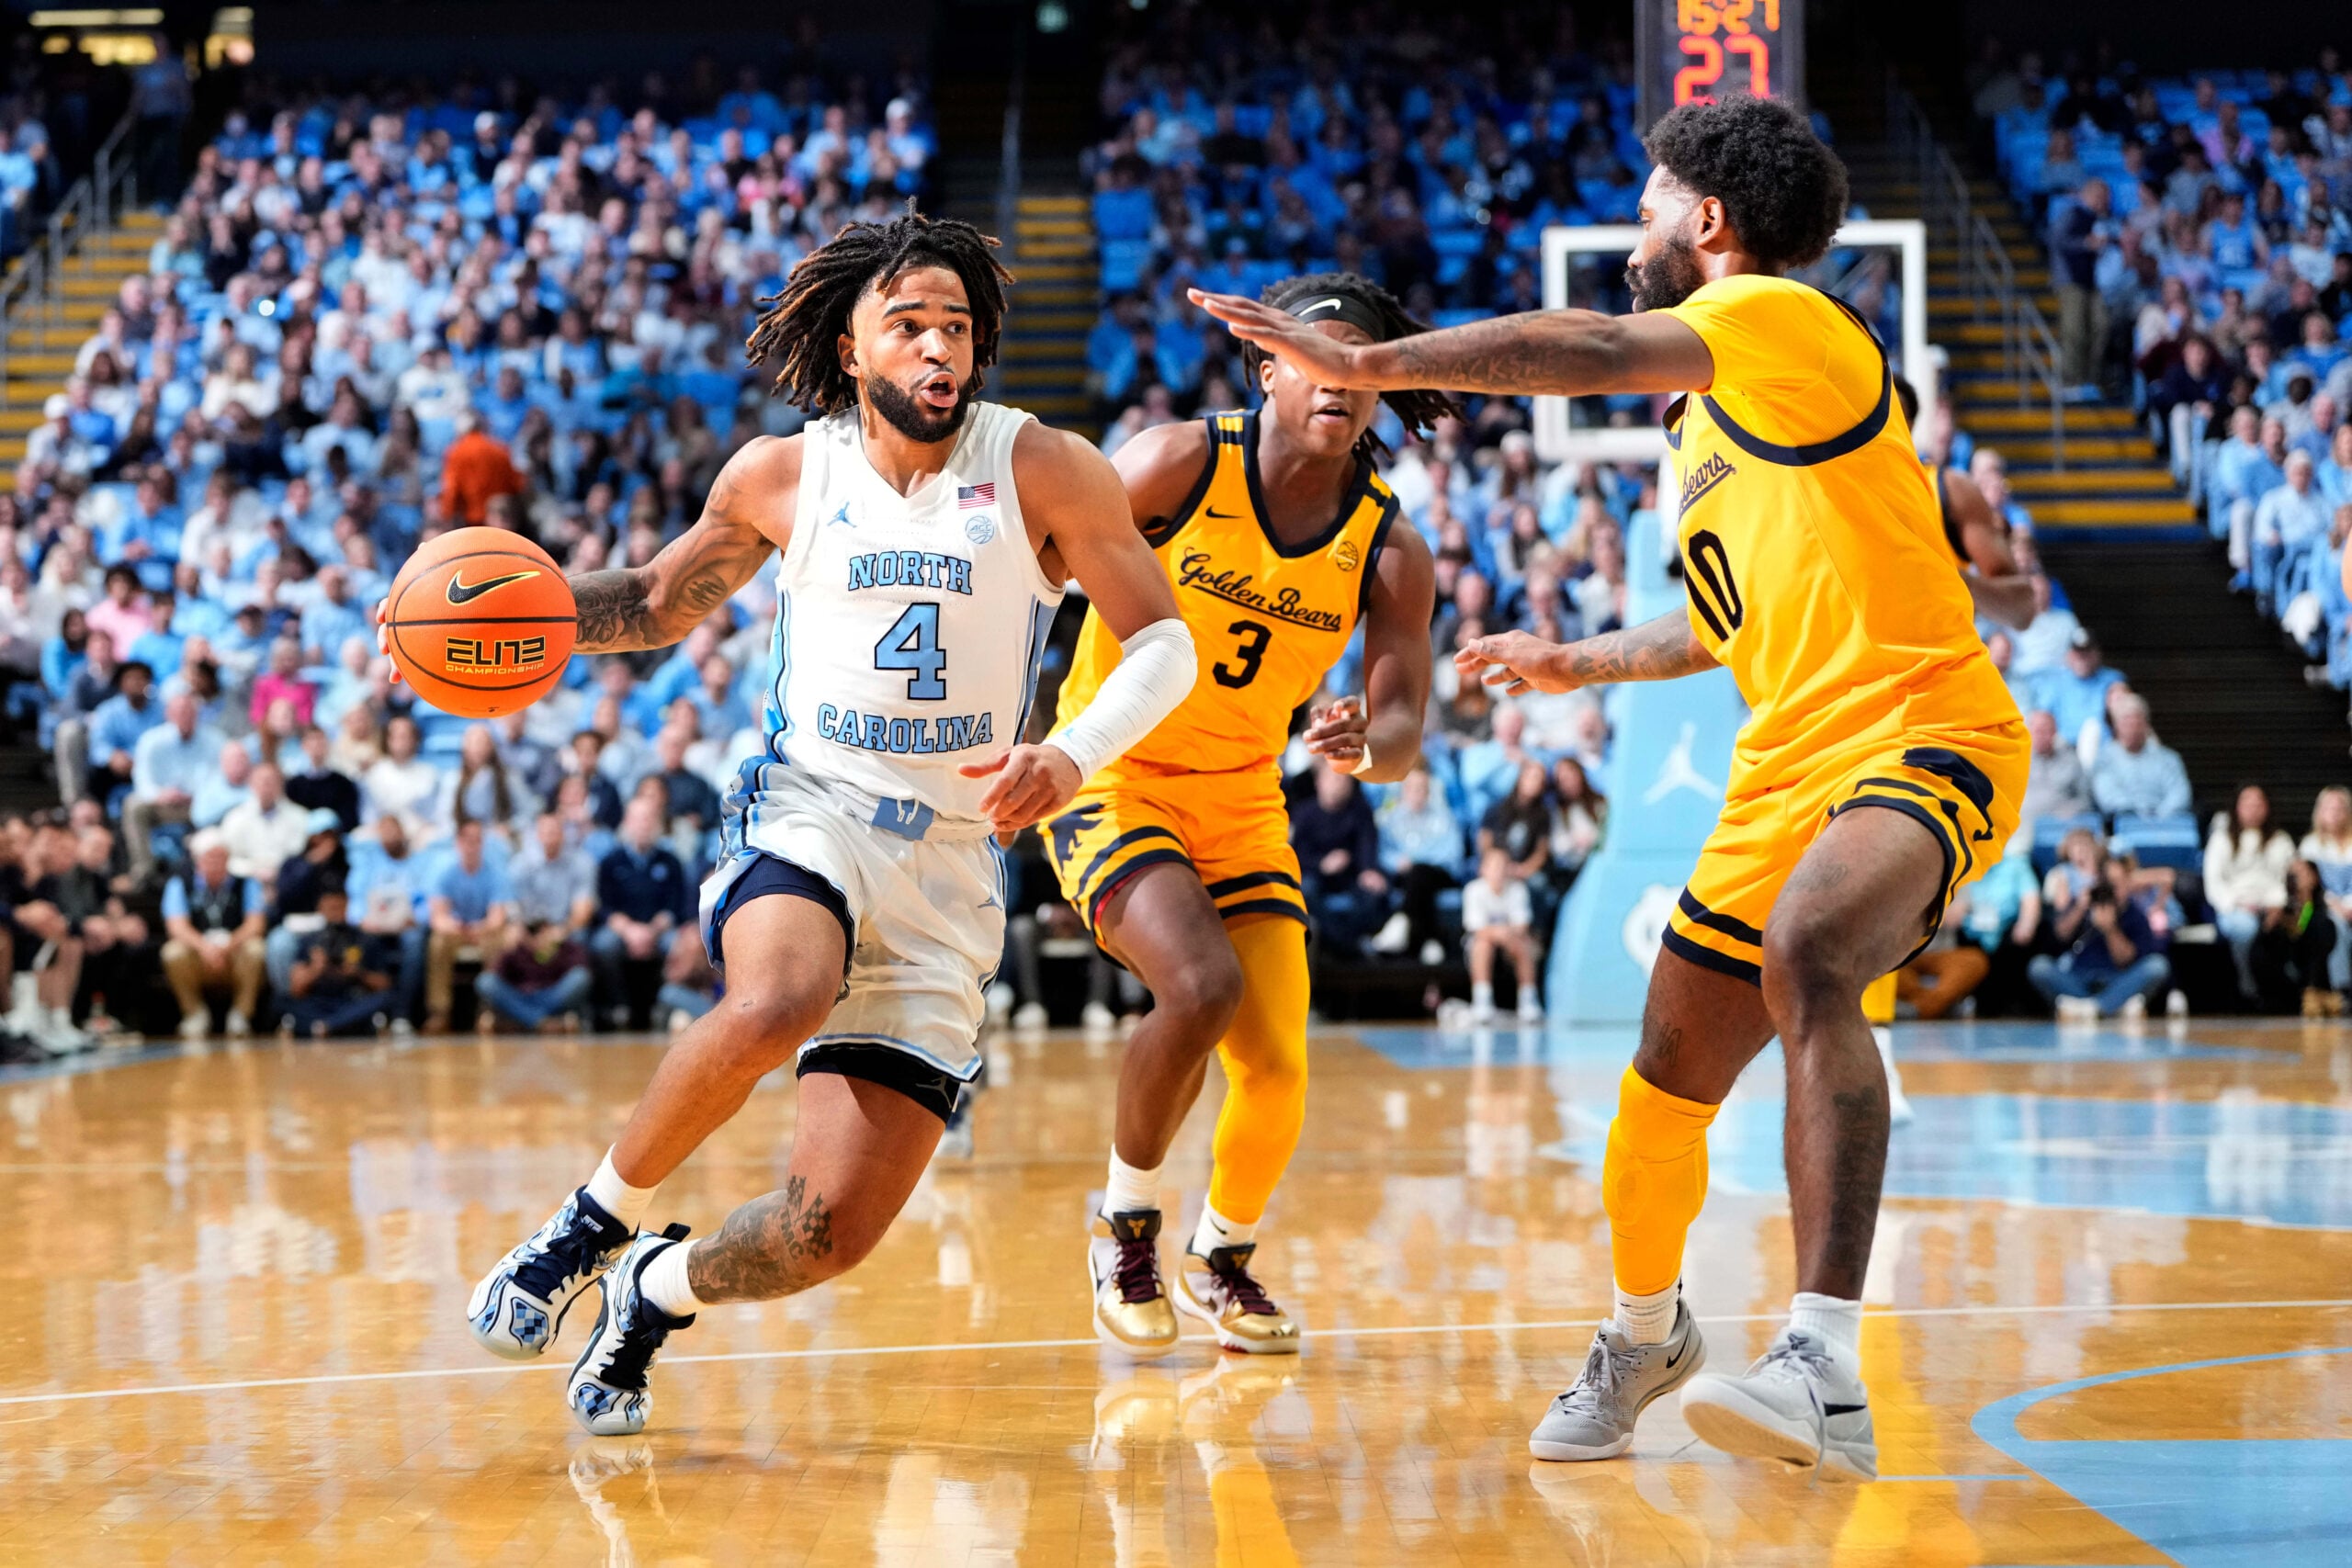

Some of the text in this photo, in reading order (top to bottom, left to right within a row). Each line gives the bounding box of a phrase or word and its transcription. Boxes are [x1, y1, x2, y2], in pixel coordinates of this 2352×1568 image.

[1674, 34, 1770, 107] 27
[848, 550, 973, 595] NORTH
[1179, 547, 1341, 628] Golden Bears
[446, 635, 546, 666] ELITE
[446, 662, 545, 675] CHAMPIONSHIP
[875, 602, 947, 700] 4
[1212, 619, 1272, 689] 3
[817, 703, 993, 753] CAROLINA
